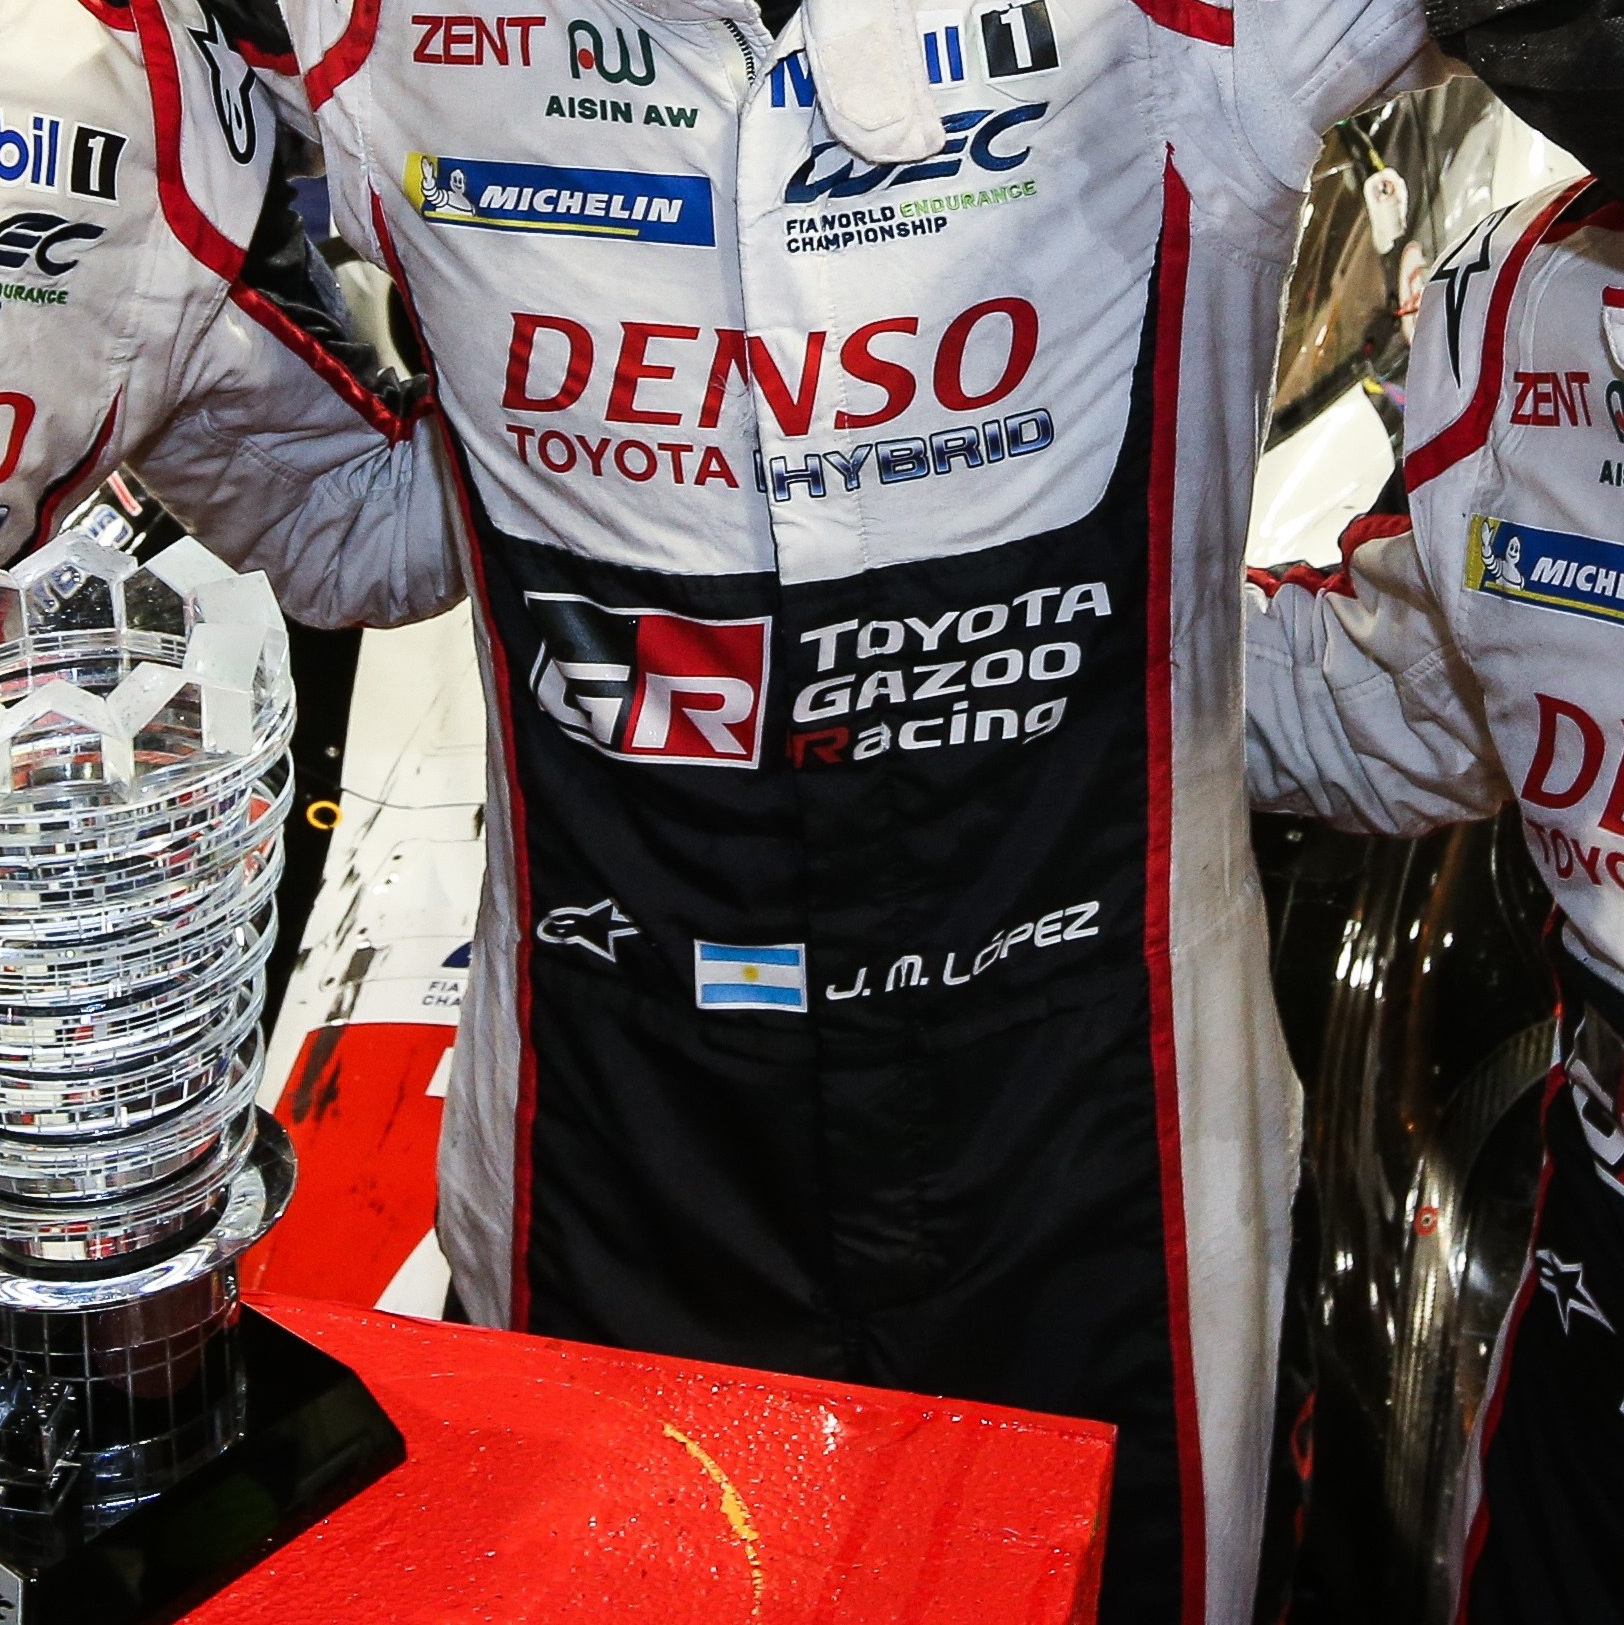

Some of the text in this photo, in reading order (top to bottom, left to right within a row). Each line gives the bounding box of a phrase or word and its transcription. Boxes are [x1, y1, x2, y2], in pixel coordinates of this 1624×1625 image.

[411, 15, 546, 67] ZENT
[771, 25, 963, 109] Mil
[545, 95, 699, 129] AISIN AW
[479, 185, 684, 224] MICHELIN
[899, 180, 1038, 217] ENDURANCE
[786, 216, 948, 253] CHAMPIONSHIP
[501, 296, 1040, 438] DENSO
[1510, 372, 1592, 427] ZENT
[506, 407, 1054, 503] TOYOTA HYBRID
[800, 582, 1113, 672] TOYOTA
[792, 641, 1082, 724] GAZOO
[537, 662, 1068, 768] GR Racing
[428, 980, 459, 993] FIA
